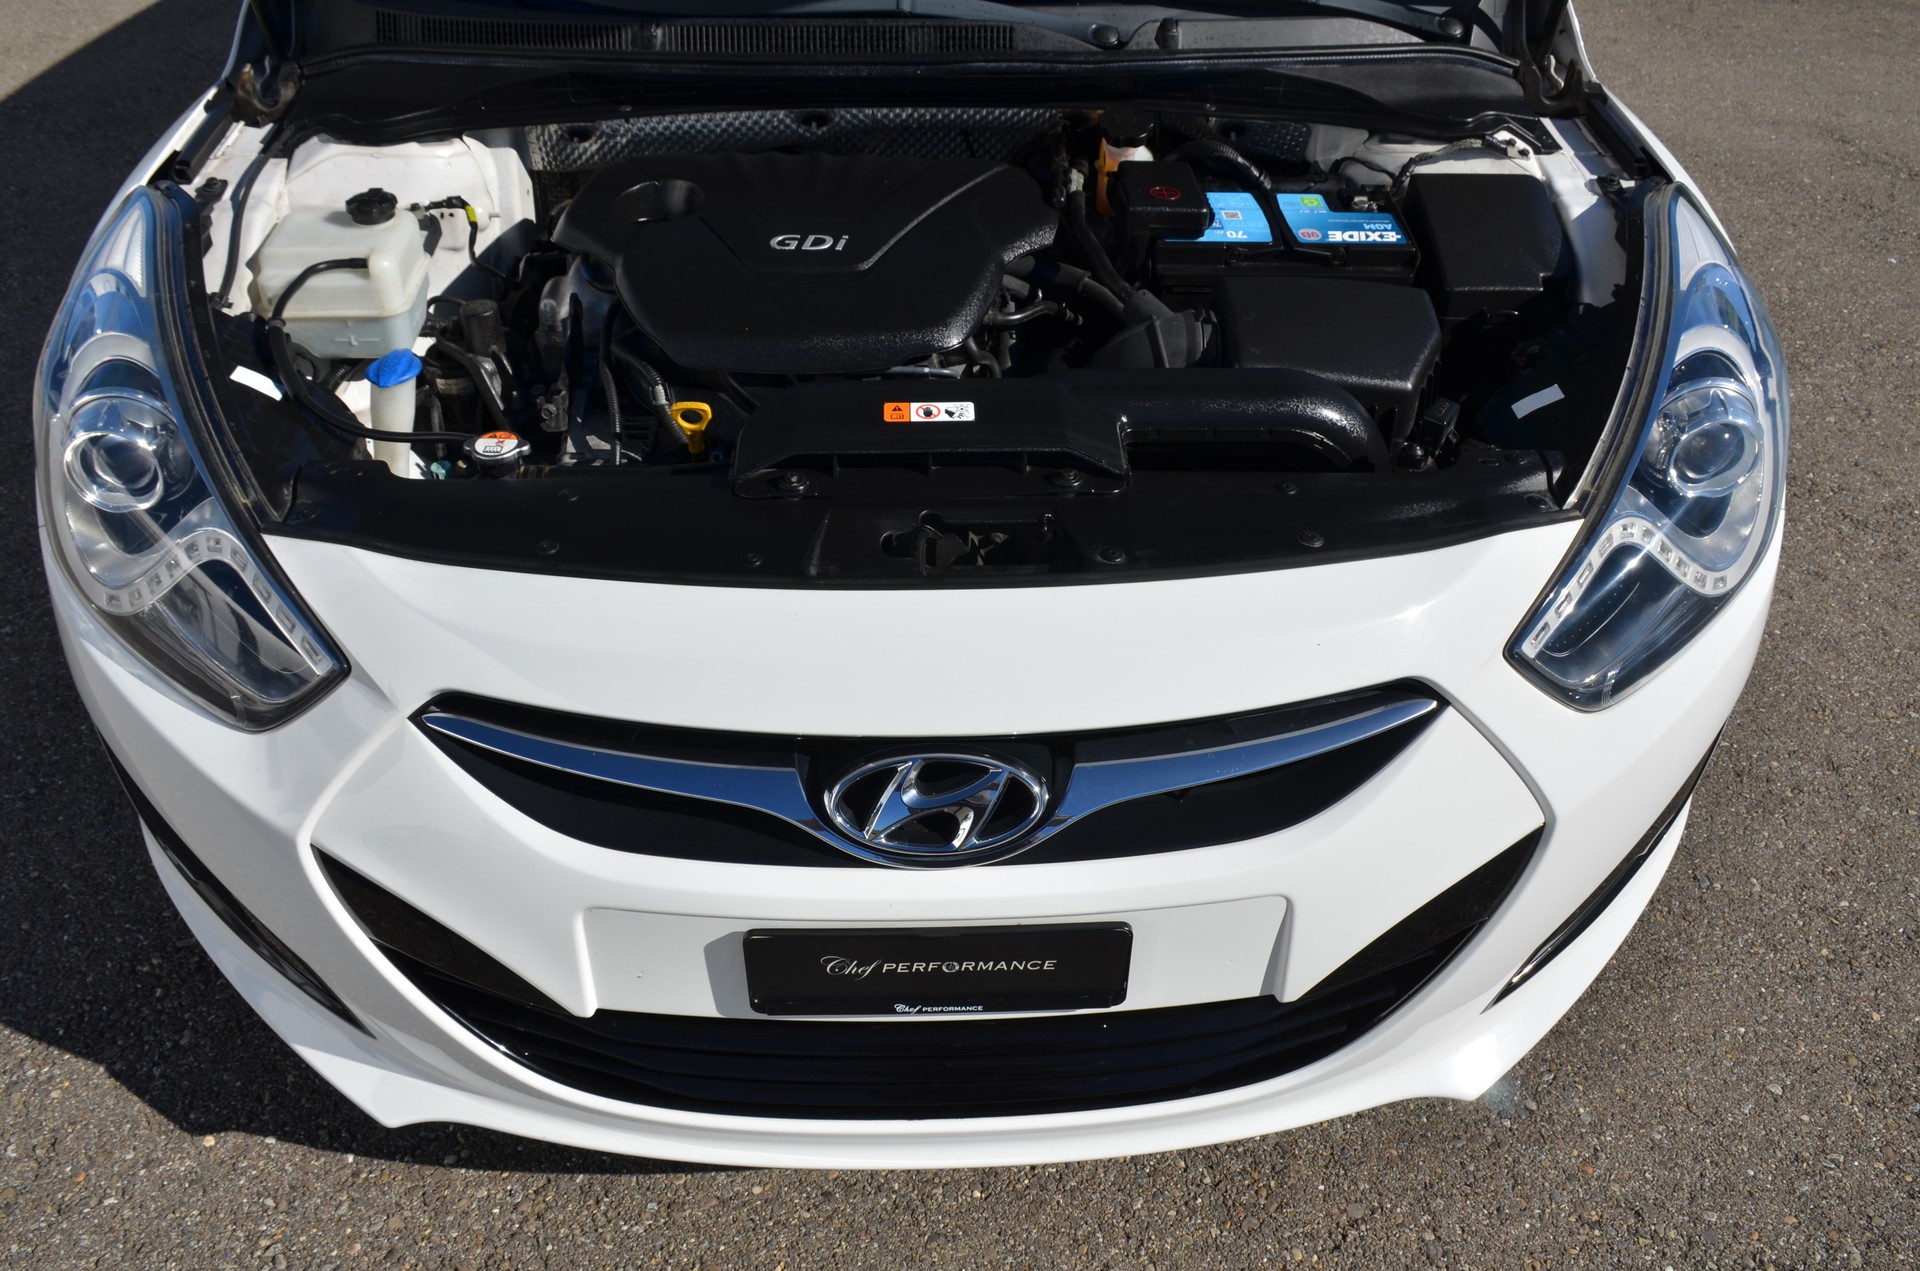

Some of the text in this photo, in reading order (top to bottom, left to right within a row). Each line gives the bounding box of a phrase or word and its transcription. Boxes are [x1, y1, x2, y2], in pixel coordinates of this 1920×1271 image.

[1363, 223, 1392, 231] AGM
[1226, 230, 1248, 239] 70
[1327, 230, 1401, 242] EXIDE
[769, 234, 849, 251] GDi
[820, 955, 1058, 981] Chef PERFORMANCE
[893, 1003, 984, 1015] Chef PERFORMANCE
